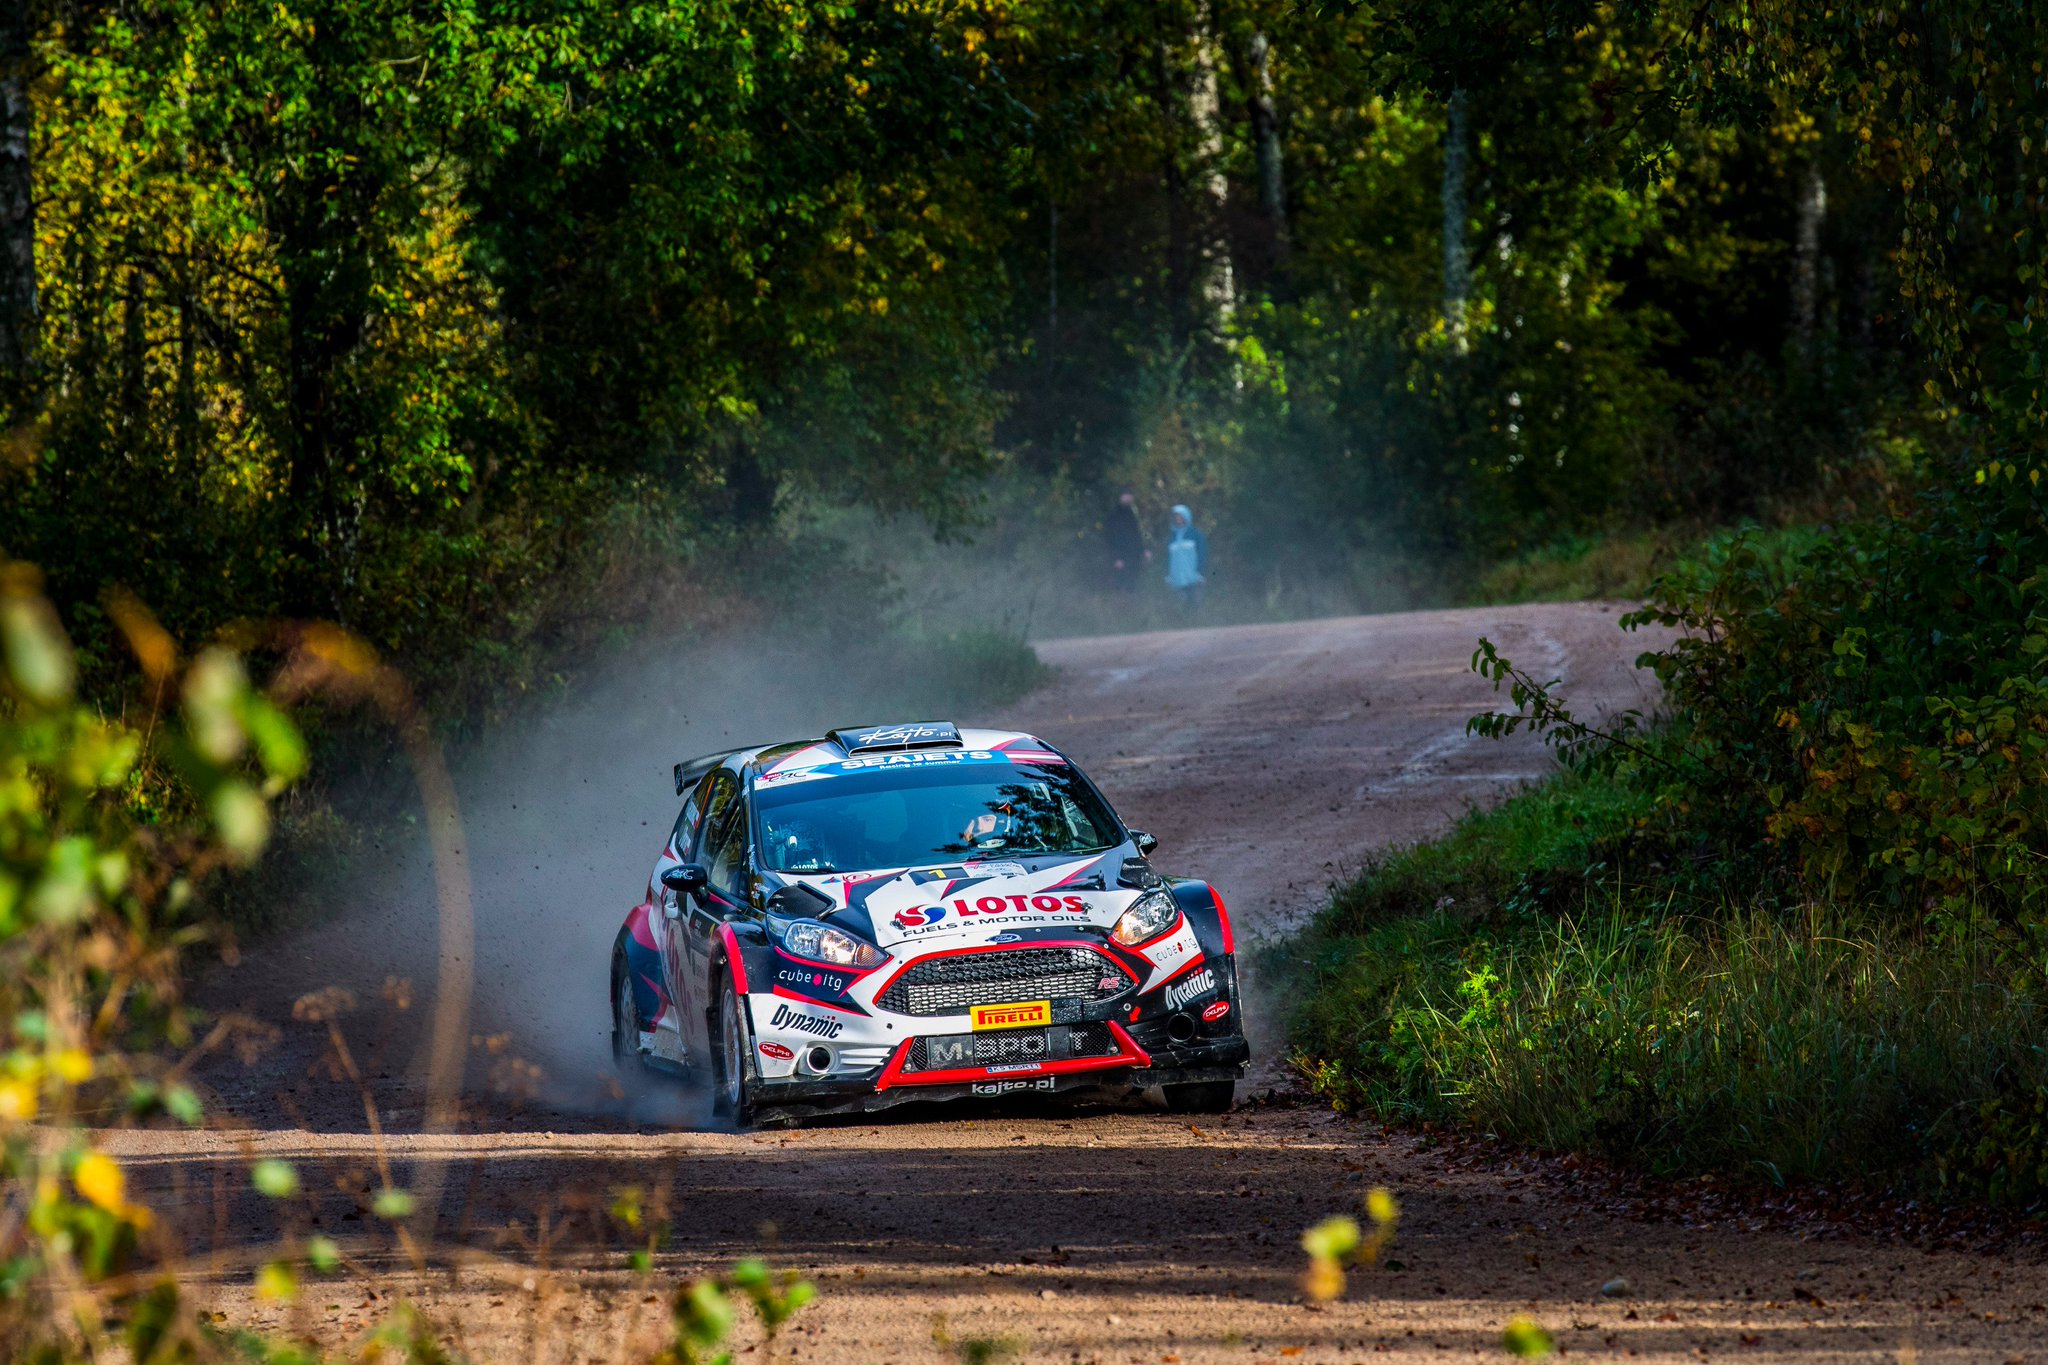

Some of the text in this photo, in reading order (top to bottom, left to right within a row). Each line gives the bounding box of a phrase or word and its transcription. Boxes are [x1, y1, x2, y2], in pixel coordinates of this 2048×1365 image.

[840, 750, 993, 769] SEAJETS
[927, 868, 947, 880] 1
[953, 894, 1085, 917] LOTOS
[903, 914, 1093, 938] FUELS & MOTOR OILS
[1097, 976, 1121, 990] RS
[1164, 967, 1216, 1012] Dynamic
[770, 1003, 844, 1039] Dynamic
[977, 1005, 1043, 1026] PIRELLI
[1205, 1004, 1227, 1019] DELPHI
[761, 1044, 791, 1058] DELPHI
[971, 1076, 1056, 1097] kajto.pl
